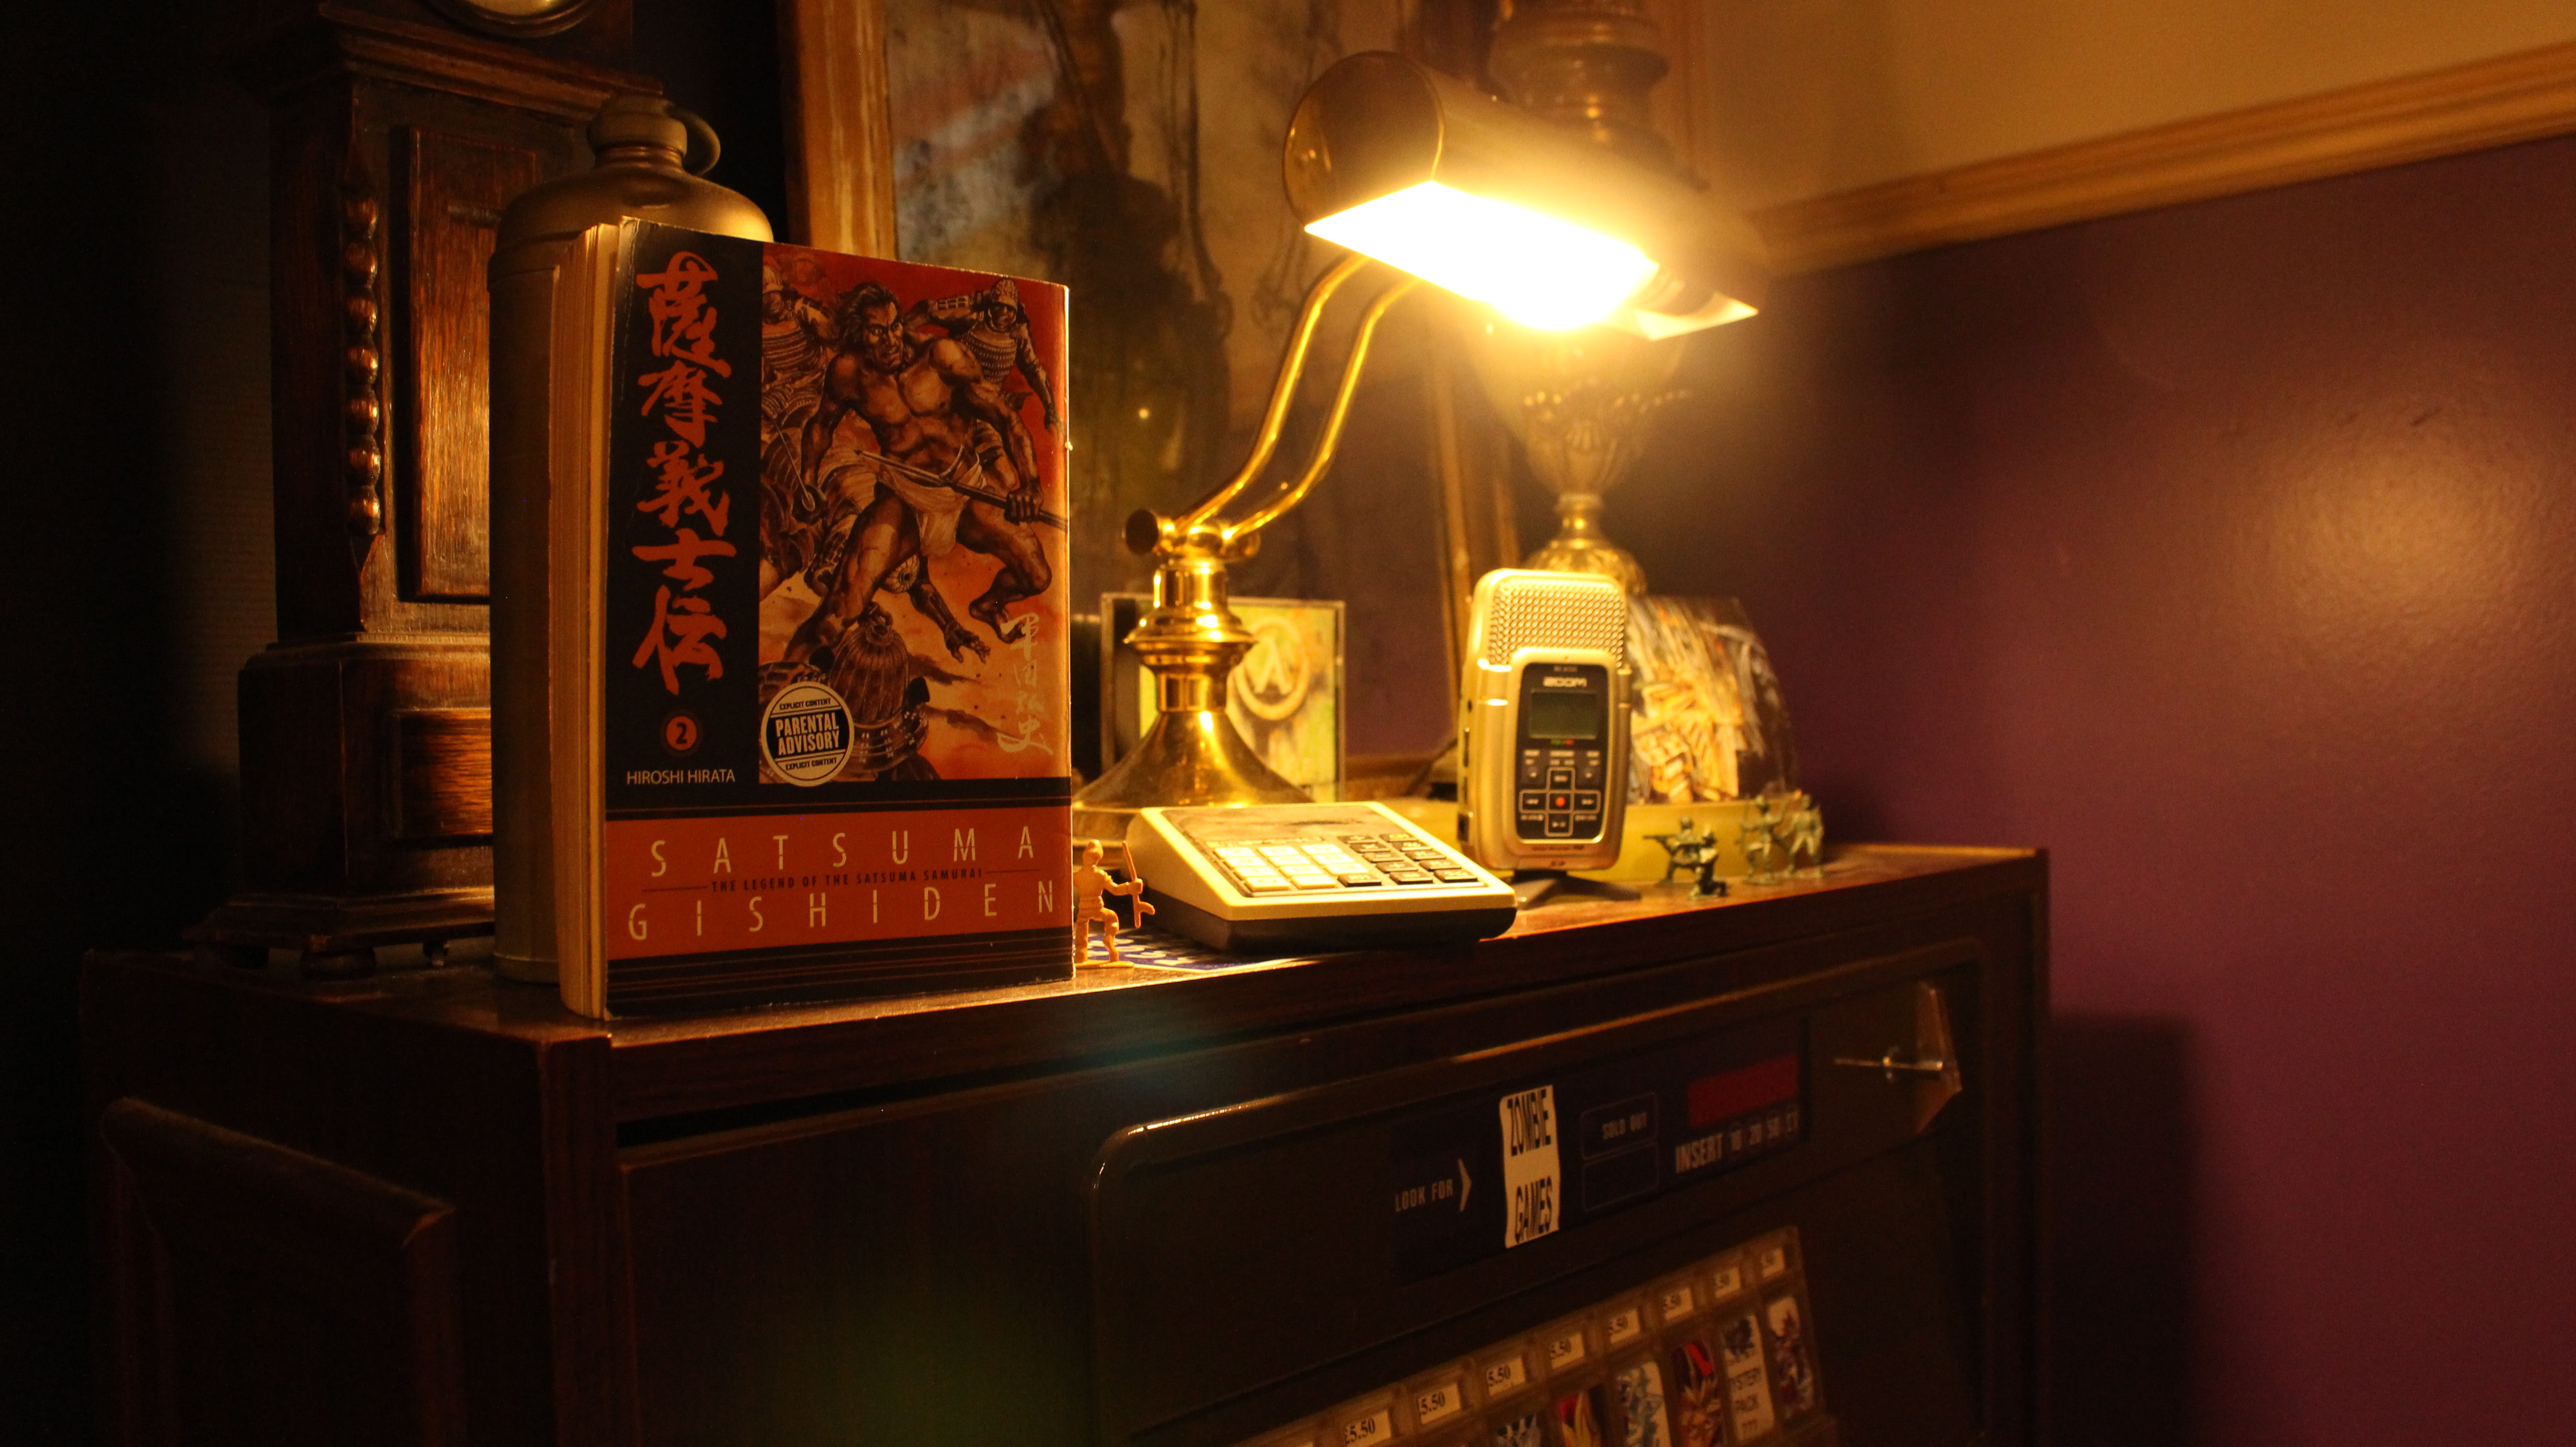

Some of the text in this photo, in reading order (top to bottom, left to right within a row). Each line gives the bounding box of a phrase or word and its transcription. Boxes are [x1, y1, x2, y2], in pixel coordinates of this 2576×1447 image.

[632, 251, 737, 695] 薩摩義士伝
[779, 698, 831, 710] EXPLICIT CONTENT
[676, 724, 688, 745] 2
[775, 713, 839, 737] PARENTAL
[777, 731, 840, 756] ADVISORY
[627, 769, 735, 785] HIROSHI HIRATA
[785, 757, 837, 771] EXPLICIT CONTENT
[650, 825, 1034, 878] SATSUMA
[712, 867, 983, 893] THE LEGEND OF THE SATSUMA SAMURAI
[628, 881, 1054, 942] GISHIDEN
[1507, 1088, 1552, 1158] ZOMBIE
[1602, 1120, 1626, 1140] SOLD
[1675, 1136, 1724, 1174] INSERT
[1394, 1179, 1453, 1213] LOOK FOR
[1515, 1177, 1552, 1244] GAMES
